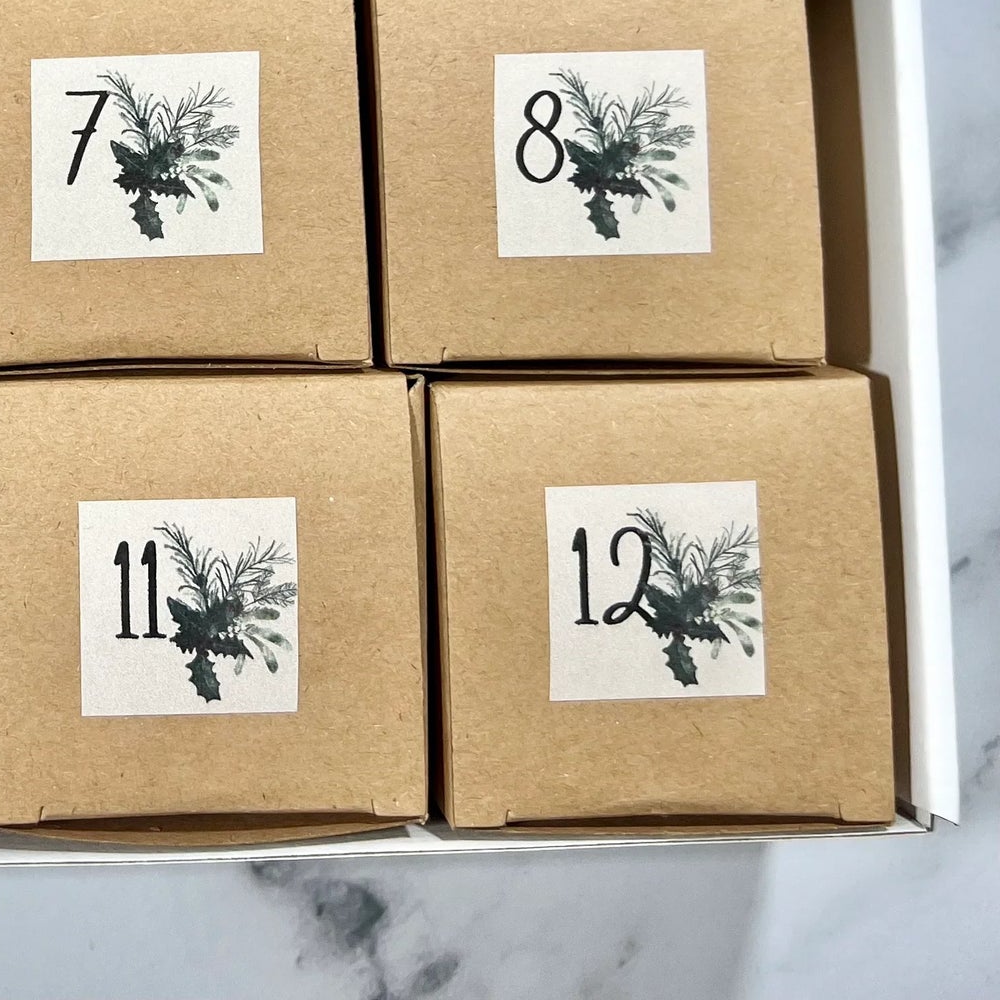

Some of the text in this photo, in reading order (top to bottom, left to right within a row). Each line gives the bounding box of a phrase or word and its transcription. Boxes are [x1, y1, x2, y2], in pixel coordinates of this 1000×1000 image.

[65, 90, 111, 185] 7
[516, 90, 564, 183] 8
[113, 540, 167, 639] 11
[571, 526, 653, 625] 12
